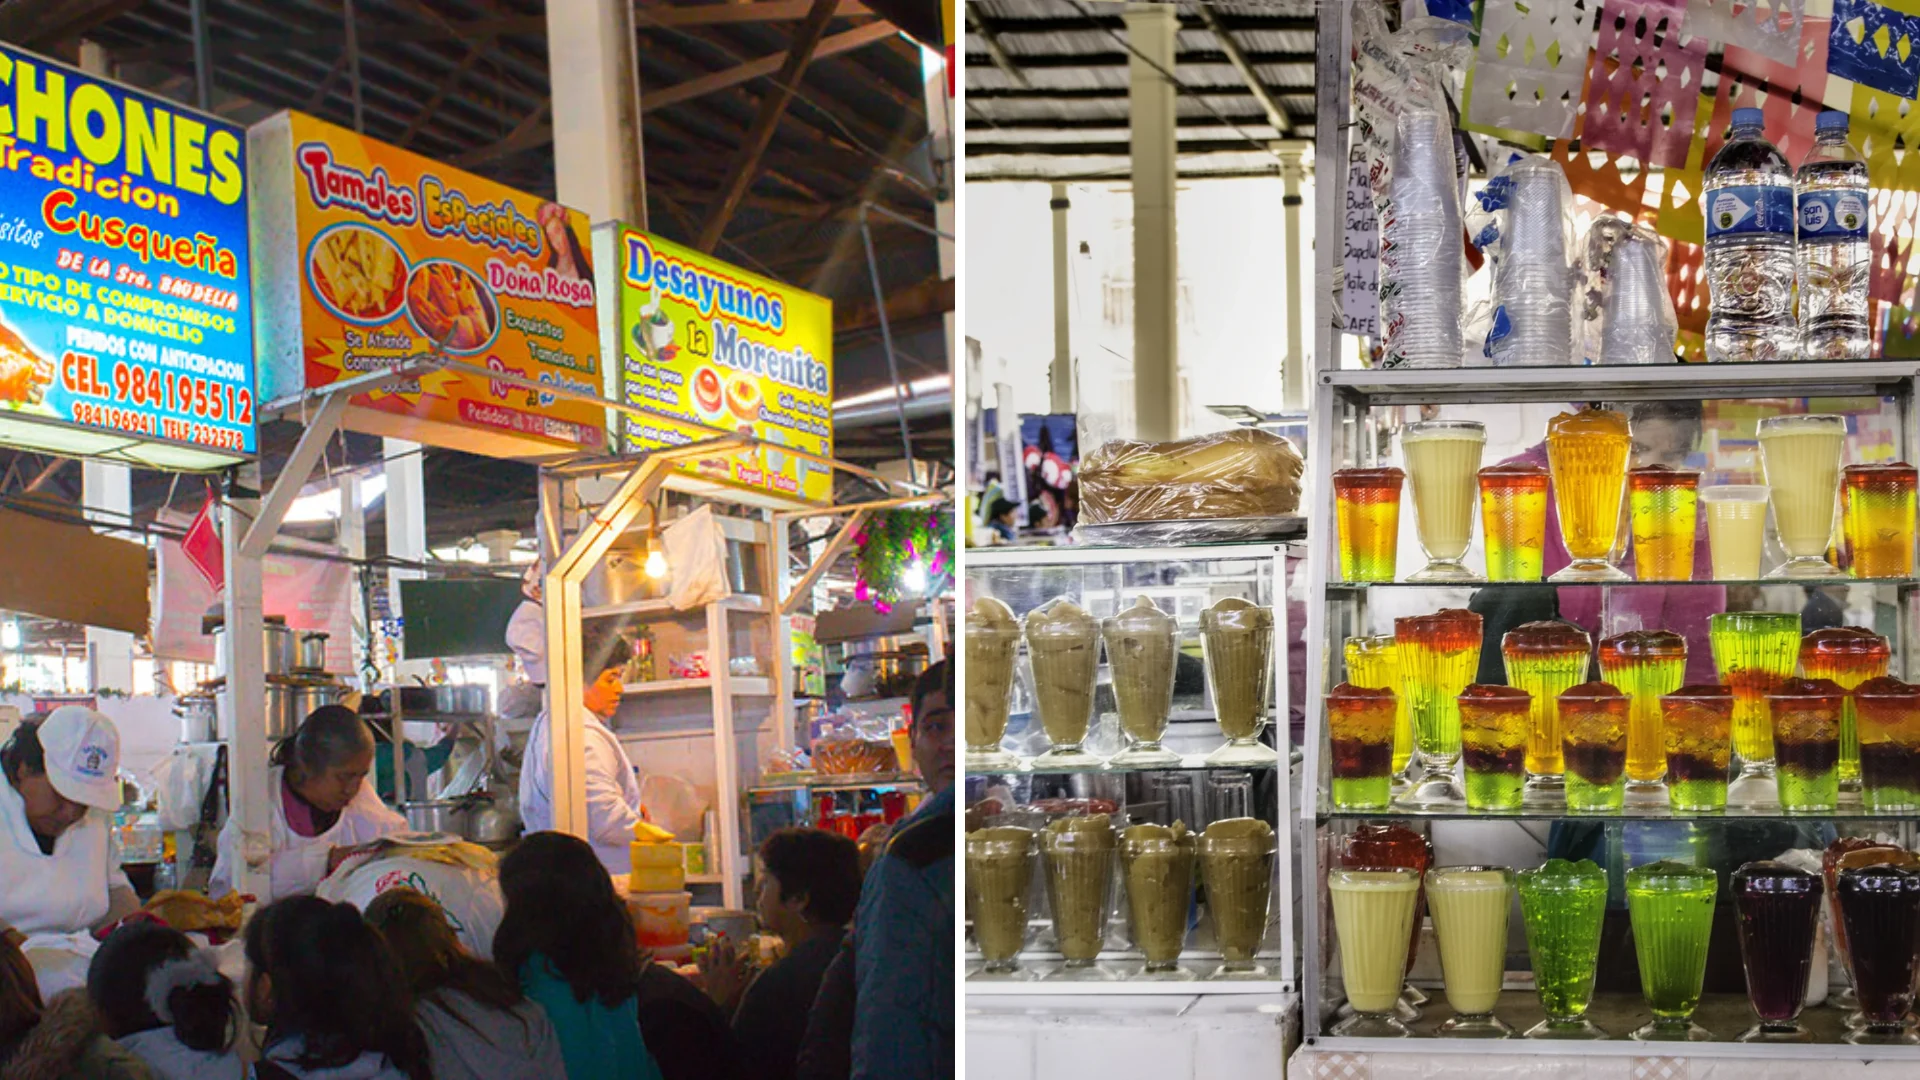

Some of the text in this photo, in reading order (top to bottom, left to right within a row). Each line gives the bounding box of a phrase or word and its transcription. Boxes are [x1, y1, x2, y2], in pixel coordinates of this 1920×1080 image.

[0, 52, 243, 205] HONES
[299, 145, 417, 223] Tamales
[1804, 205, 1822, 216] san
[42, 188, 237, 280] Cusqueña
[1804, 215, 1823, 226] luis
[56, 248, 84, 272] DE
[88, 256, 111, 280] LA
[115, 264, 152, 290] Sra.
[487, 258, 594, 306] Doña Rosa
[624, 233, 785, 333] Desayunos
[12, 265, 61, 291] TIPO
[66, 278, 92, 300] DE
[97, 286, 236, 333] COMPROMISOS
[85, 303, 99, 321] A
[104, 307, 204, 344] DOMICILIO
[505, 308, 564, 341] Exquisitos
[66, 325, 246, 382] PEDIDOS CON ANTICIPACION
[345, 330, 413, 349] Se Atiende
[713, 319, 829, 394] Morenita
[61, 351, 253, 425] CEL. 984195512
[72, 402, 157, 436] 984196941
[193, 422, 244, 451] 232578
